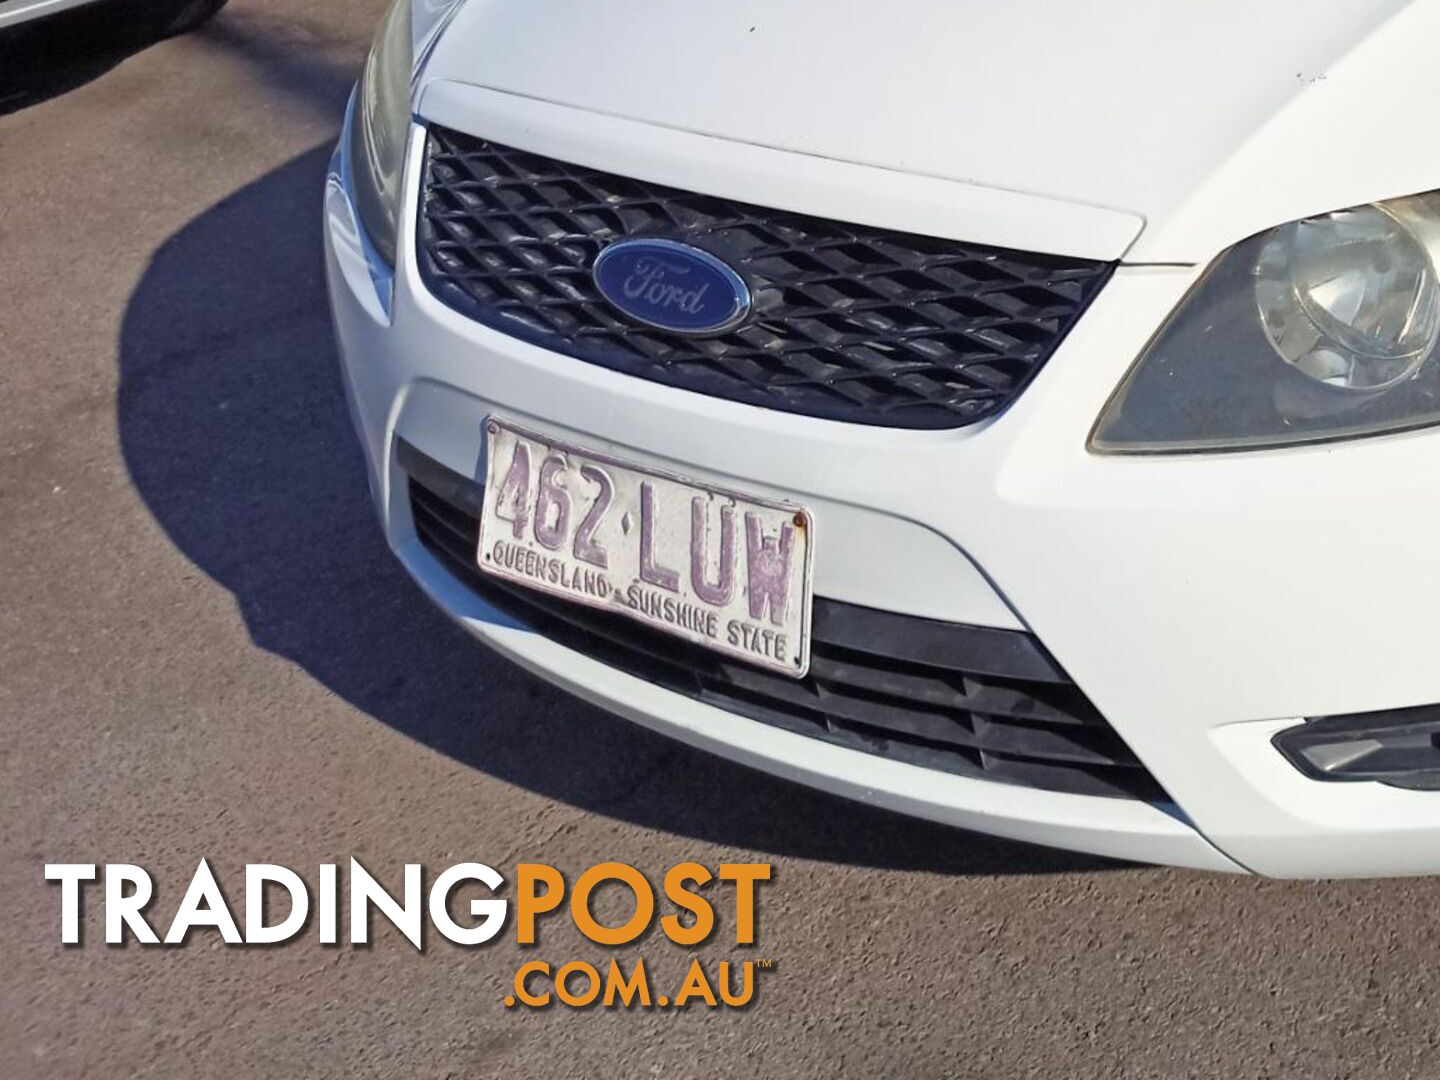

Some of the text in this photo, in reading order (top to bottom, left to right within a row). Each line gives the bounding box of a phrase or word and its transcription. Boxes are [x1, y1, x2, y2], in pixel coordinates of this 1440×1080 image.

[623, 256, 710, 314] Ford
[492, 539, 789, 662] QUEENSLAND SUNSHINE STATE
